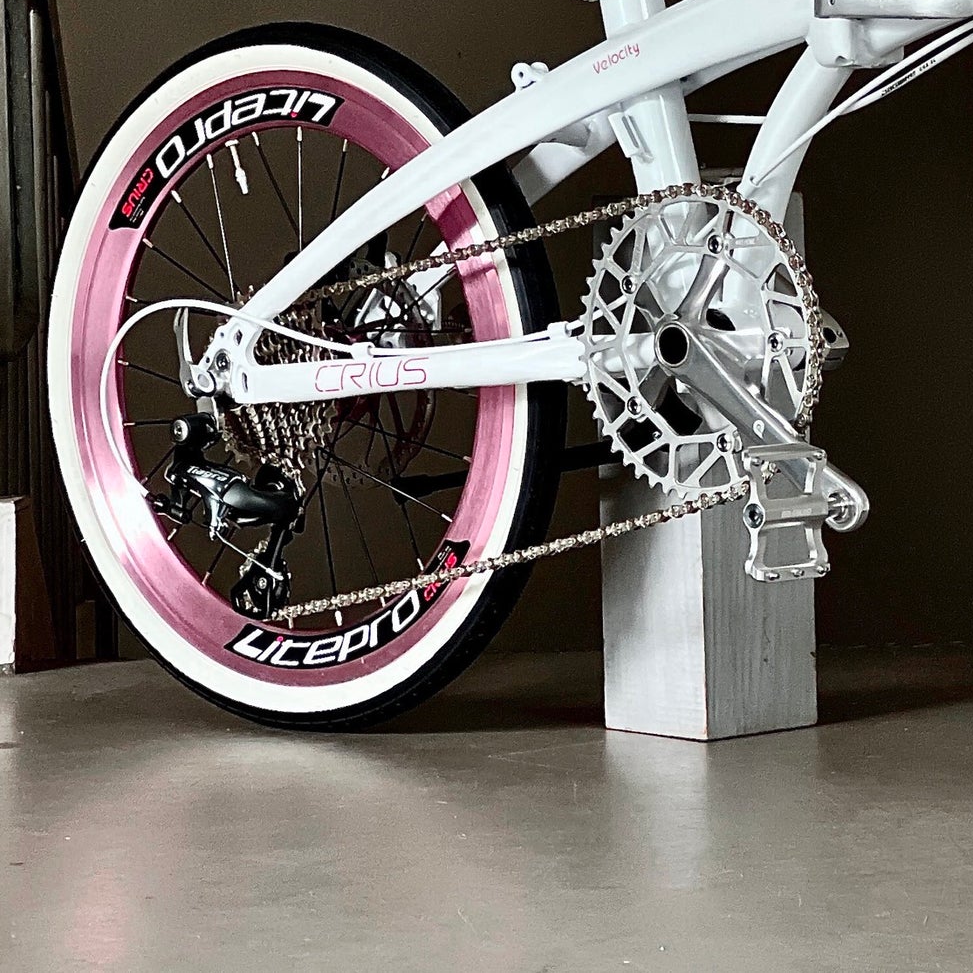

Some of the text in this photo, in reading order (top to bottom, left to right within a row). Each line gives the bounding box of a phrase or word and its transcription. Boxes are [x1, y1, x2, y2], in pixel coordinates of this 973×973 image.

[121, 168, 154, 218] CRIUS
[315, 357, 429, 392] CRIUS
[233, 589, 420, 666] Litepro
